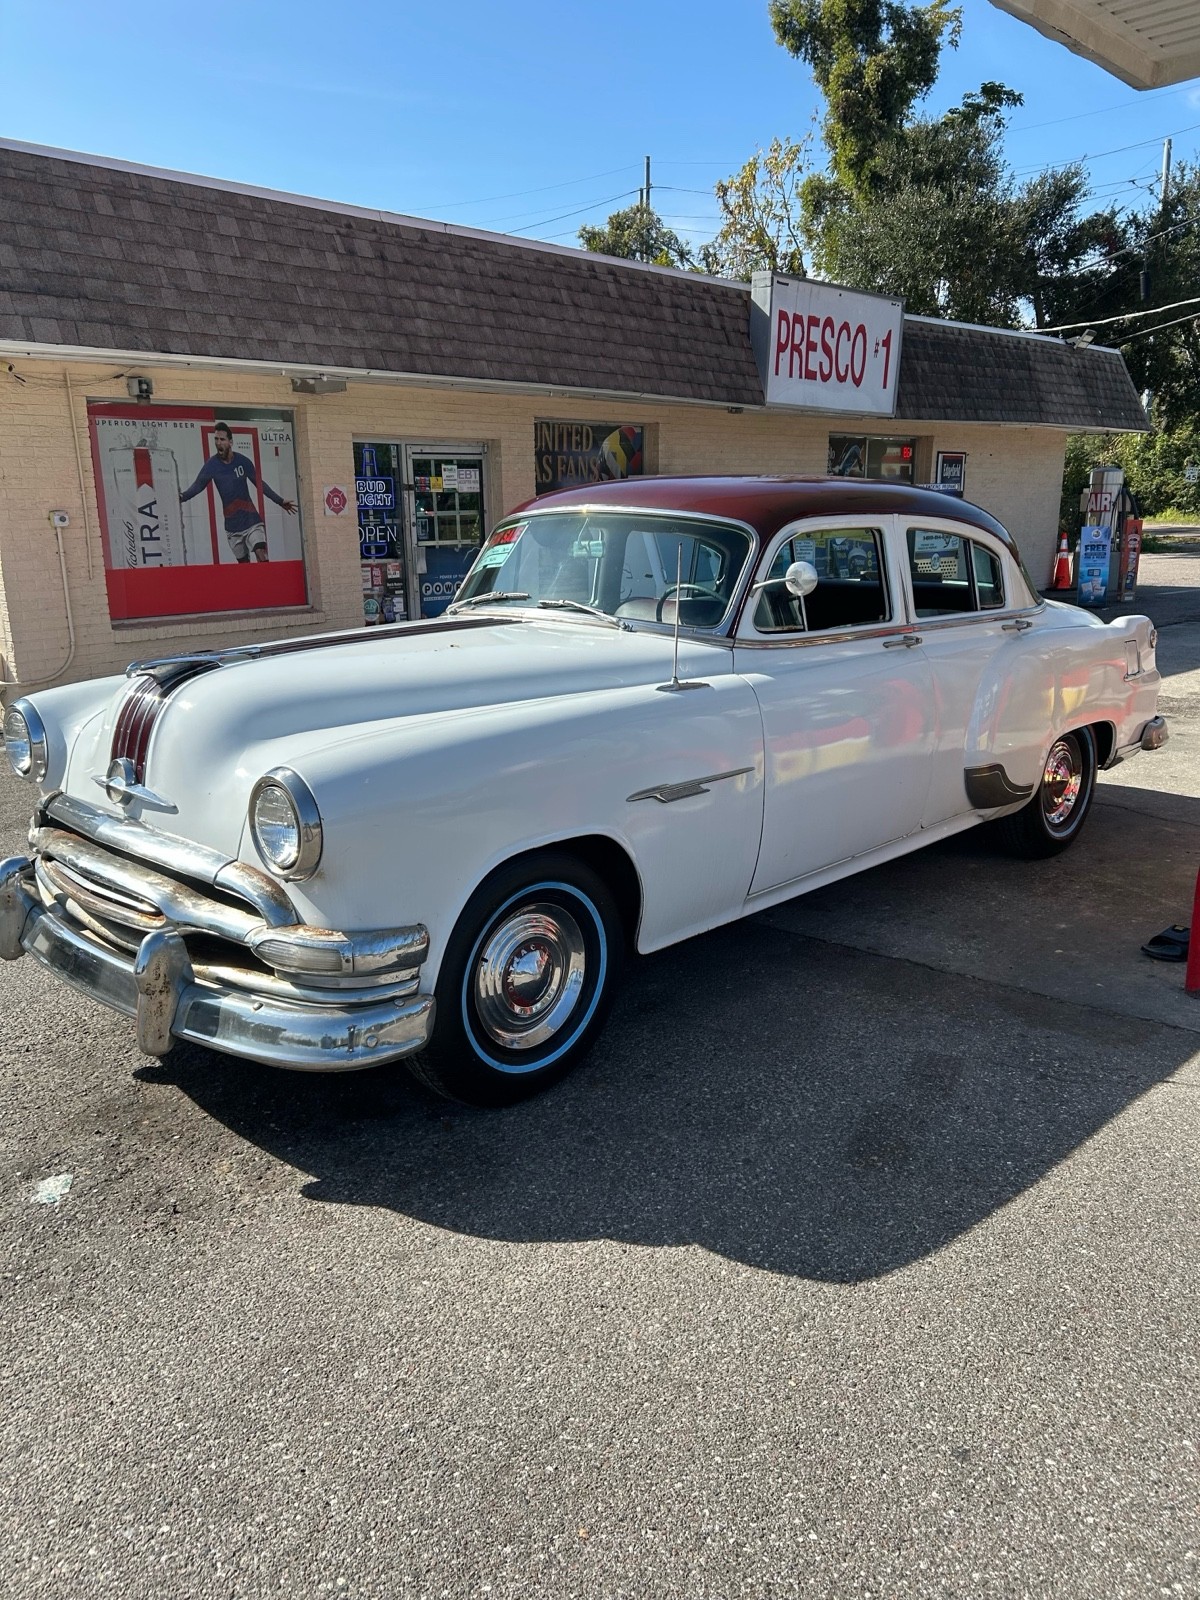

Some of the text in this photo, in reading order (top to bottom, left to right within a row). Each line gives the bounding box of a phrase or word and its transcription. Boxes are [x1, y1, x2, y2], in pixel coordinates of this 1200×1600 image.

[775, 309, 867, 388] PRESCO
[89, 419, 137, 427] SUPERIOR
[261, 433, 291, 442] ULTRA
[233, 465, 244, 478] 10
[458, 470, 479, 480] EBT
[557, 456, 600, 482] FANS
[356, 481, 386, 493] BUD
[333, 497, 340, 505] R
[356, 494, 392, 506] IGHT
[1088, 493, 1111, 511] AIR
[138, 500, 163, 566] TRA
[1084, 544, 1108, 552] FREE
[507, 944, 537, 996] ONTIAC
